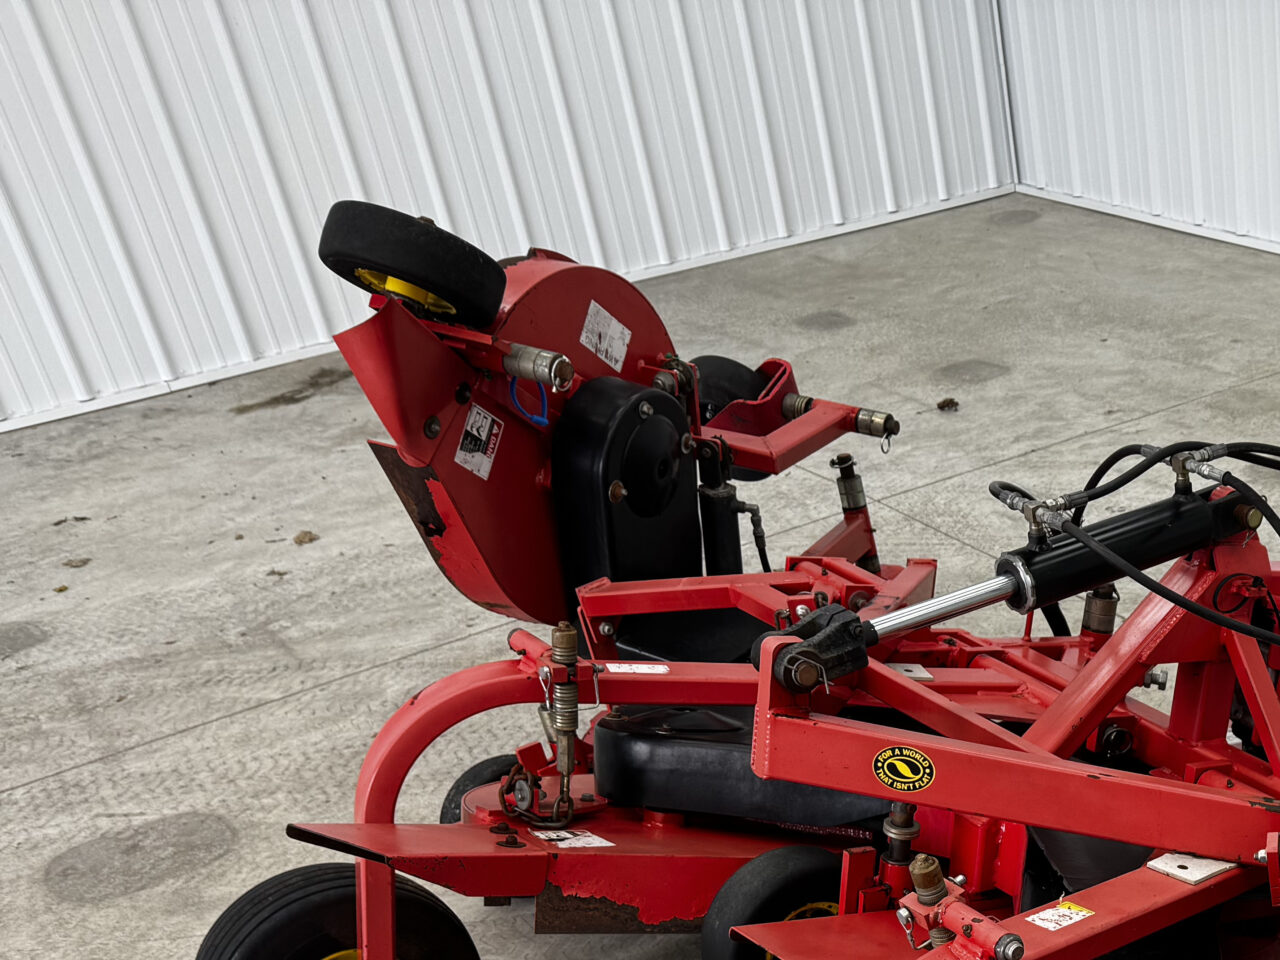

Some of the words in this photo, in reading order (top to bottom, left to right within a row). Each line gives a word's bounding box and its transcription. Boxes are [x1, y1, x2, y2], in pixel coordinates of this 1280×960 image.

[878, 750, 893, 762] FOR
[902, 748, 929, 767] WORLD
[877, 769, 893, 785] THAT
[893, 782, 914, 790] ISN'T
[915, 774, 930, 789] FLAT
